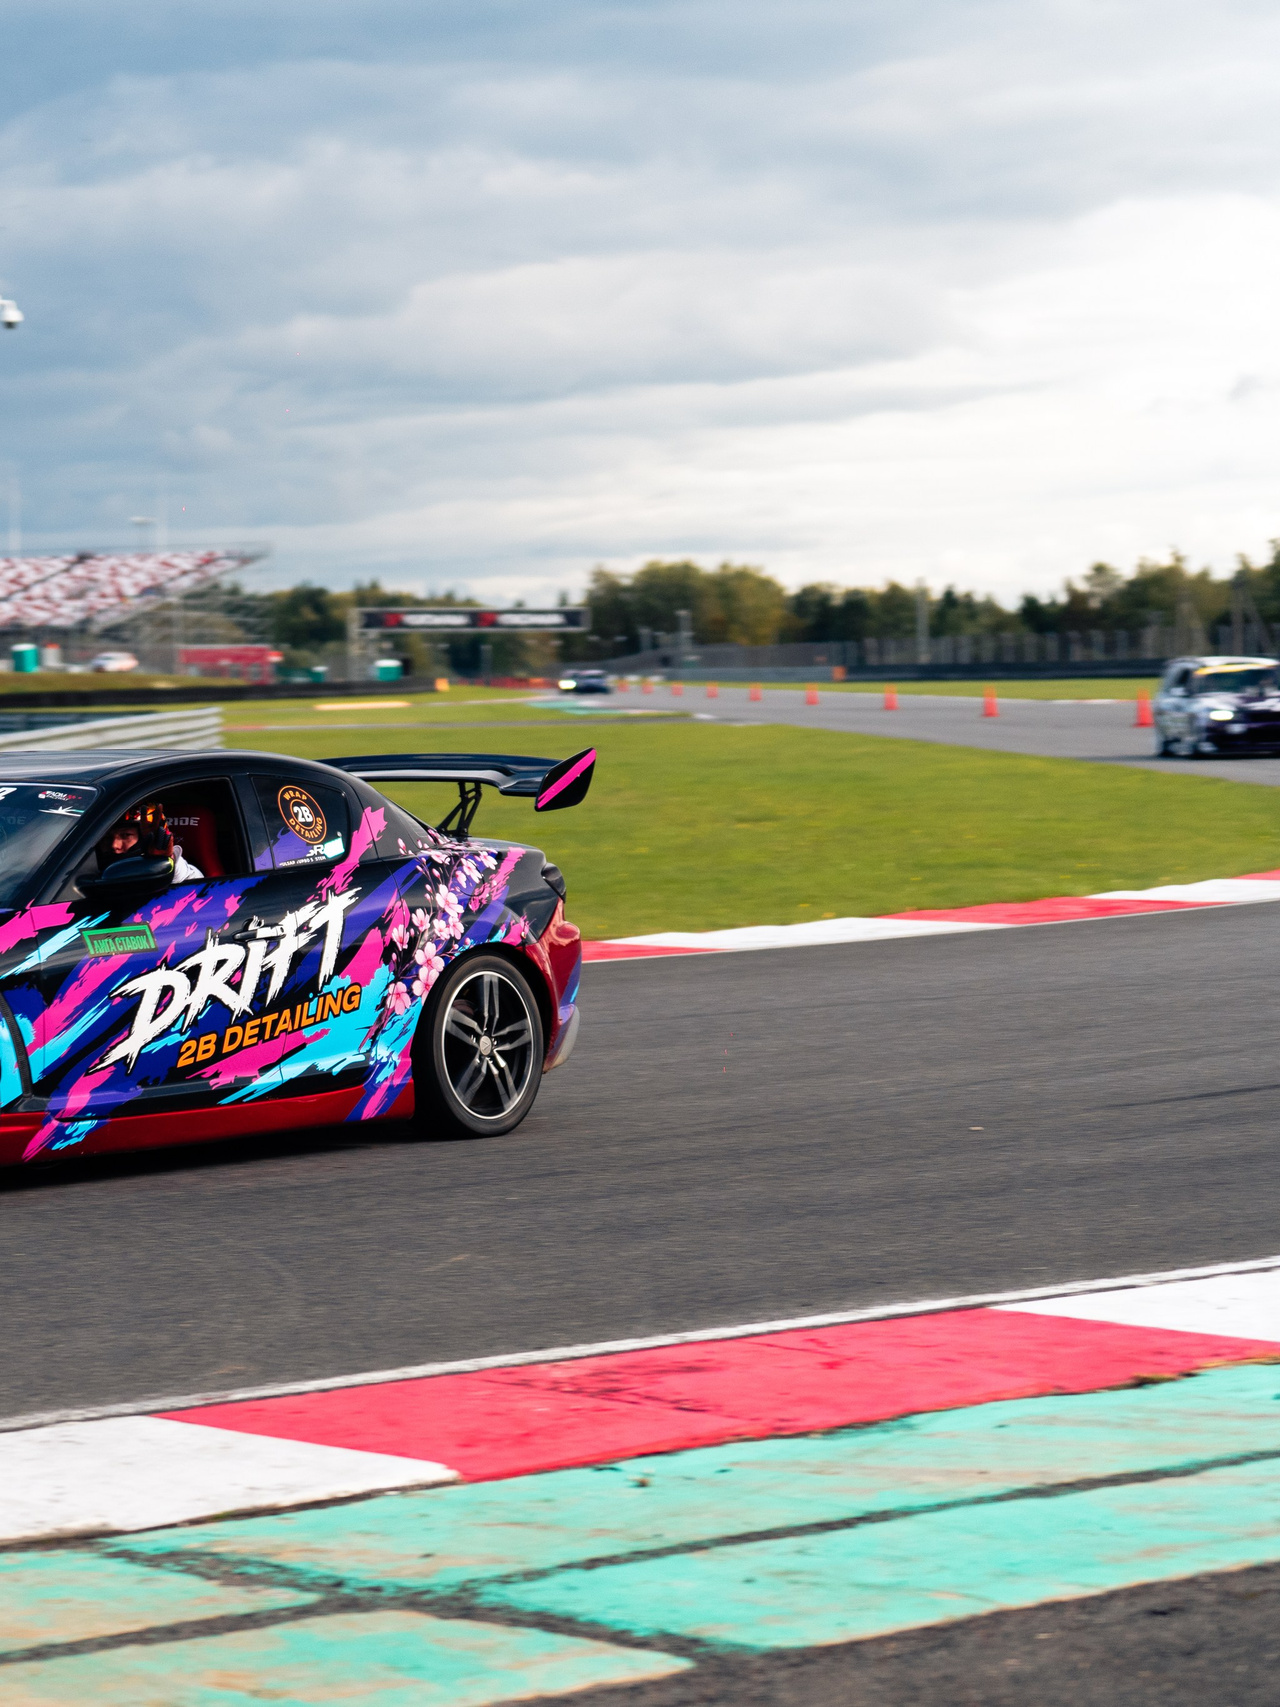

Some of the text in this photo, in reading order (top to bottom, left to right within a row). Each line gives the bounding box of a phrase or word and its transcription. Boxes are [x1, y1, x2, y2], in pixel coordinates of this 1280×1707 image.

[283, 790, 307, 800] WRAP
[167, 817, 200, 826] RIDE
[293, 806, 313, 822] 2B
[289, 818, 323, 838] DETAILING
[115, 935, 150, 952] СТАВОК
[88, 887, 362, 1074] DRIFT
[176, 984, 362, 1068] 2B DETAILING
